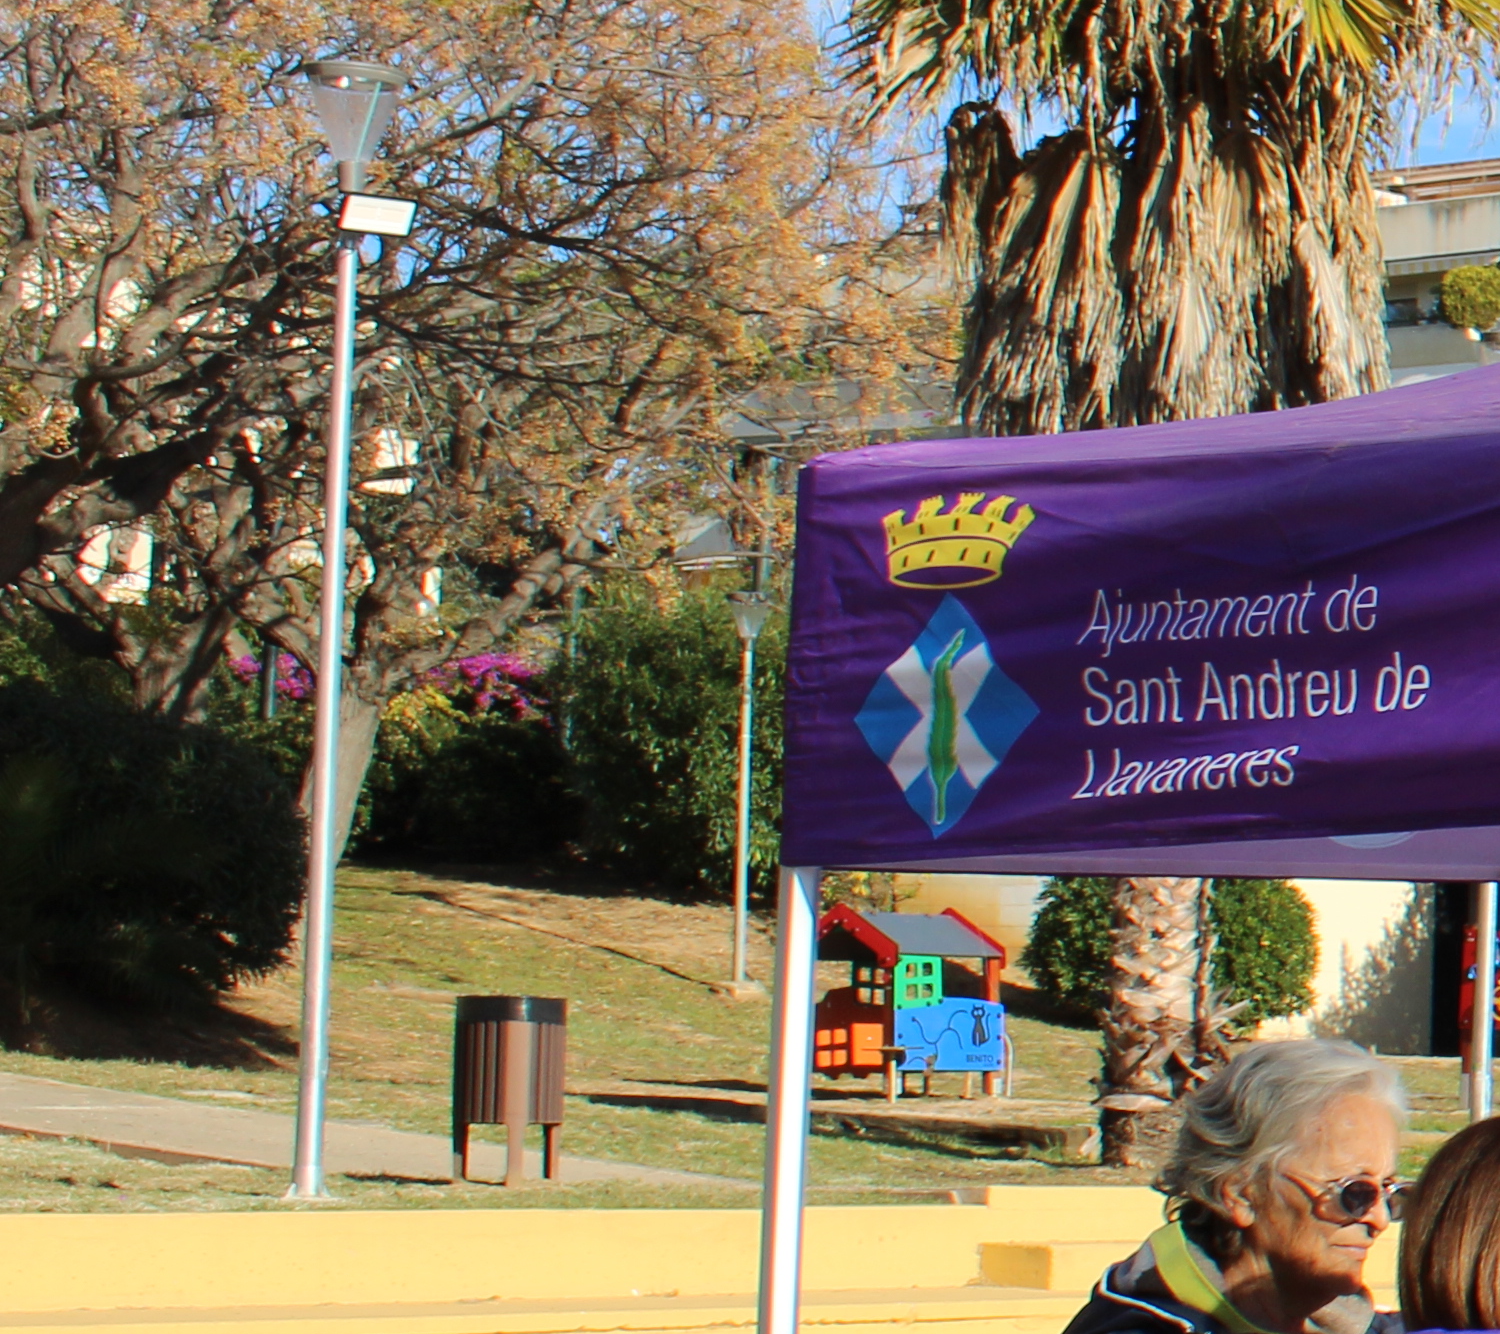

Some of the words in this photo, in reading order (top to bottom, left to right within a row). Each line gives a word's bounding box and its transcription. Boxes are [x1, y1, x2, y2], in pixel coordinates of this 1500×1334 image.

[1077, 581, 1315, 657] Ajuntament
[1325, 574, 1378, 632] de
[1082, 668, 1184, 727] Sant
[1196, 659, 1357, 722] Andreu
[1374, 652, 1431, 712] de
[1072, 745, 1299, 800] Llavaneres
